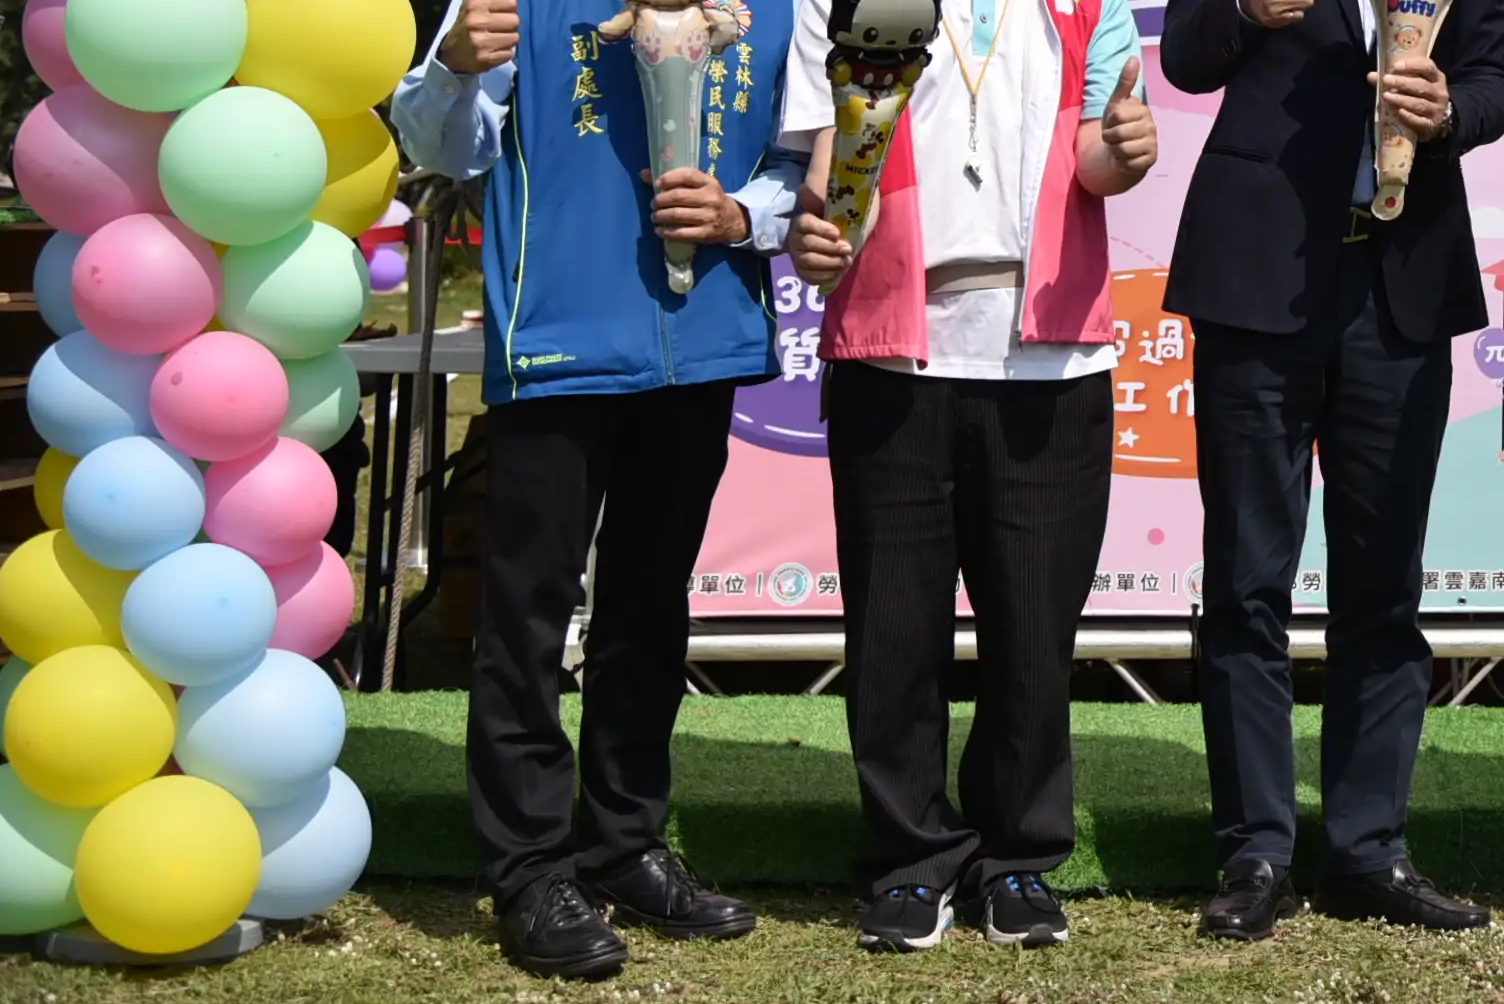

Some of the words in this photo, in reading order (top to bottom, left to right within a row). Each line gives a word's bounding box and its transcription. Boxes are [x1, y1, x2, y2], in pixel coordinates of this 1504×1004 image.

[569, 30, 605, 137] 副處長
[732, 42, 754, 115] 雲林縣
